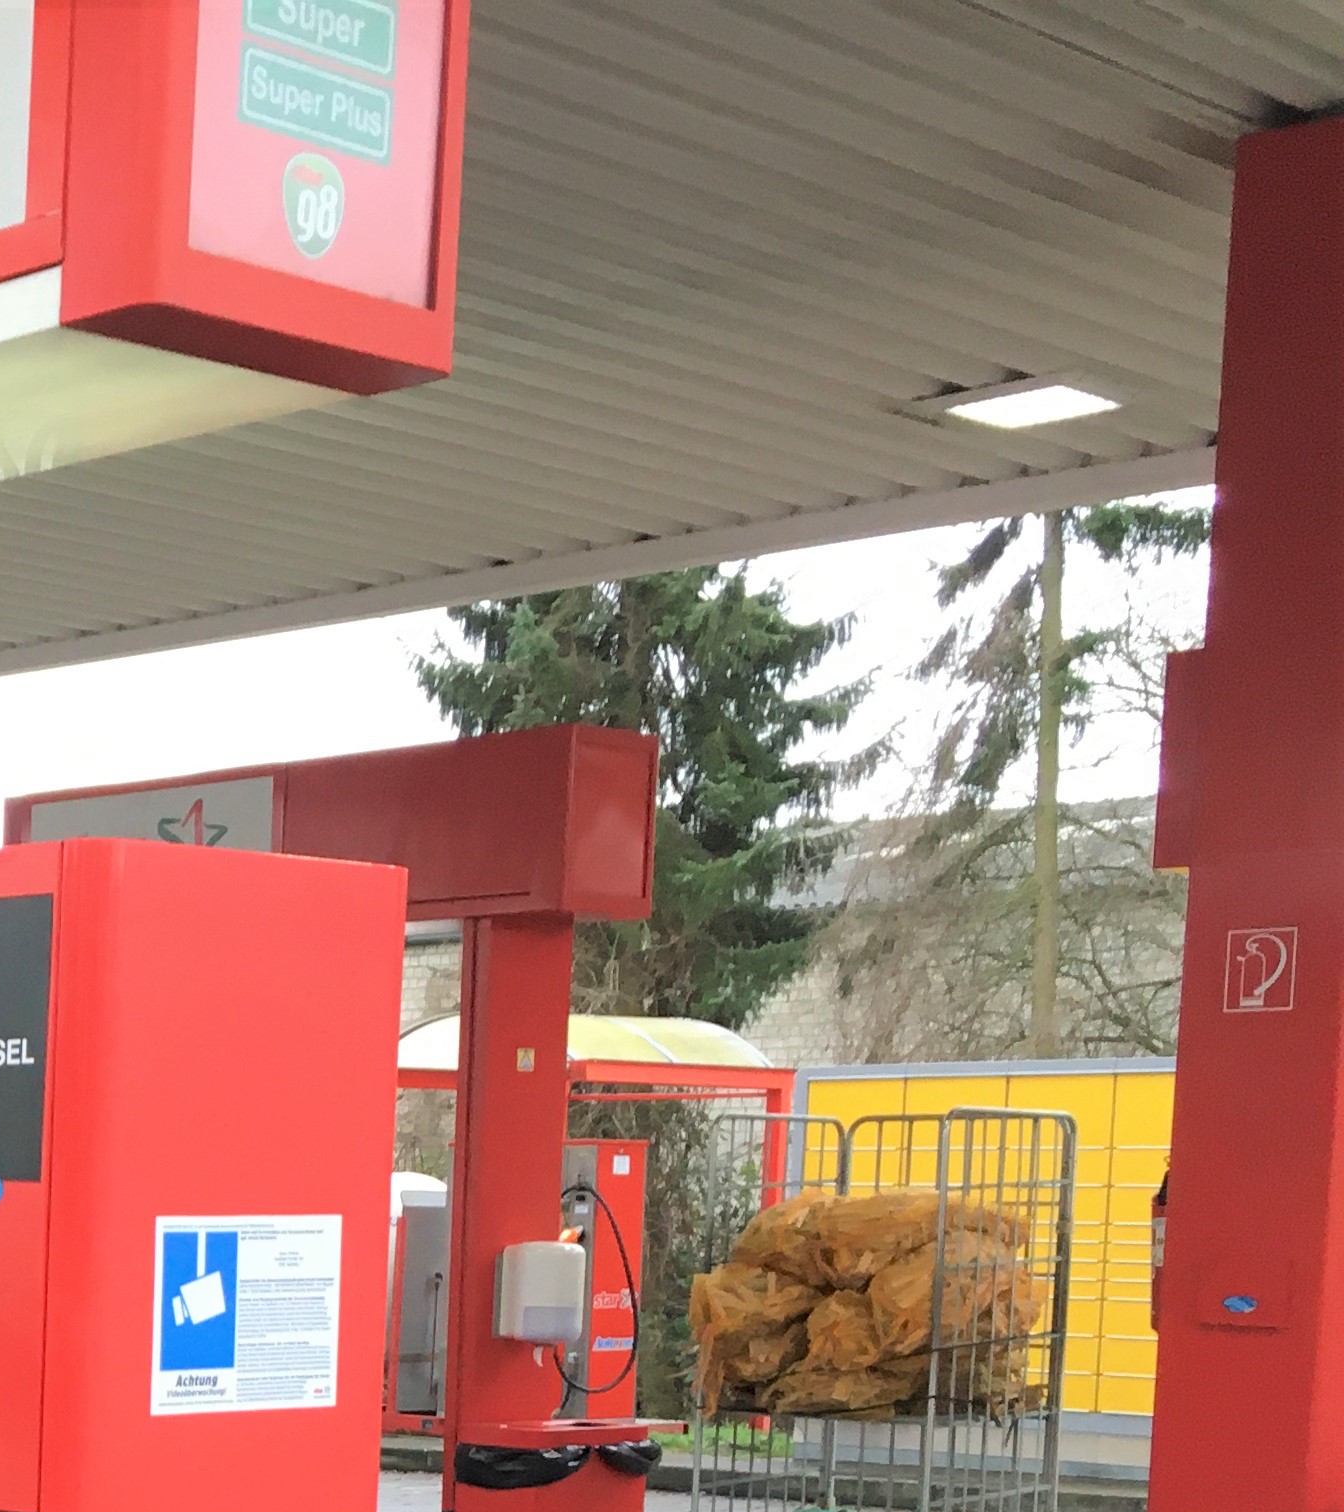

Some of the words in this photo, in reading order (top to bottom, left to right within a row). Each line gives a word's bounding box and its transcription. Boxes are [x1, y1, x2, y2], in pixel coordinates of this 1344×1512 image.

[278, 0, 366, 46] Super
[251, 65, 324, 116] Super
[330, 91, 382, 137] Plus
[296, 184, 338, 243] 98
[593, 1291, 620, 1309] star
[175, 1374, 219, 1389] Achtung
